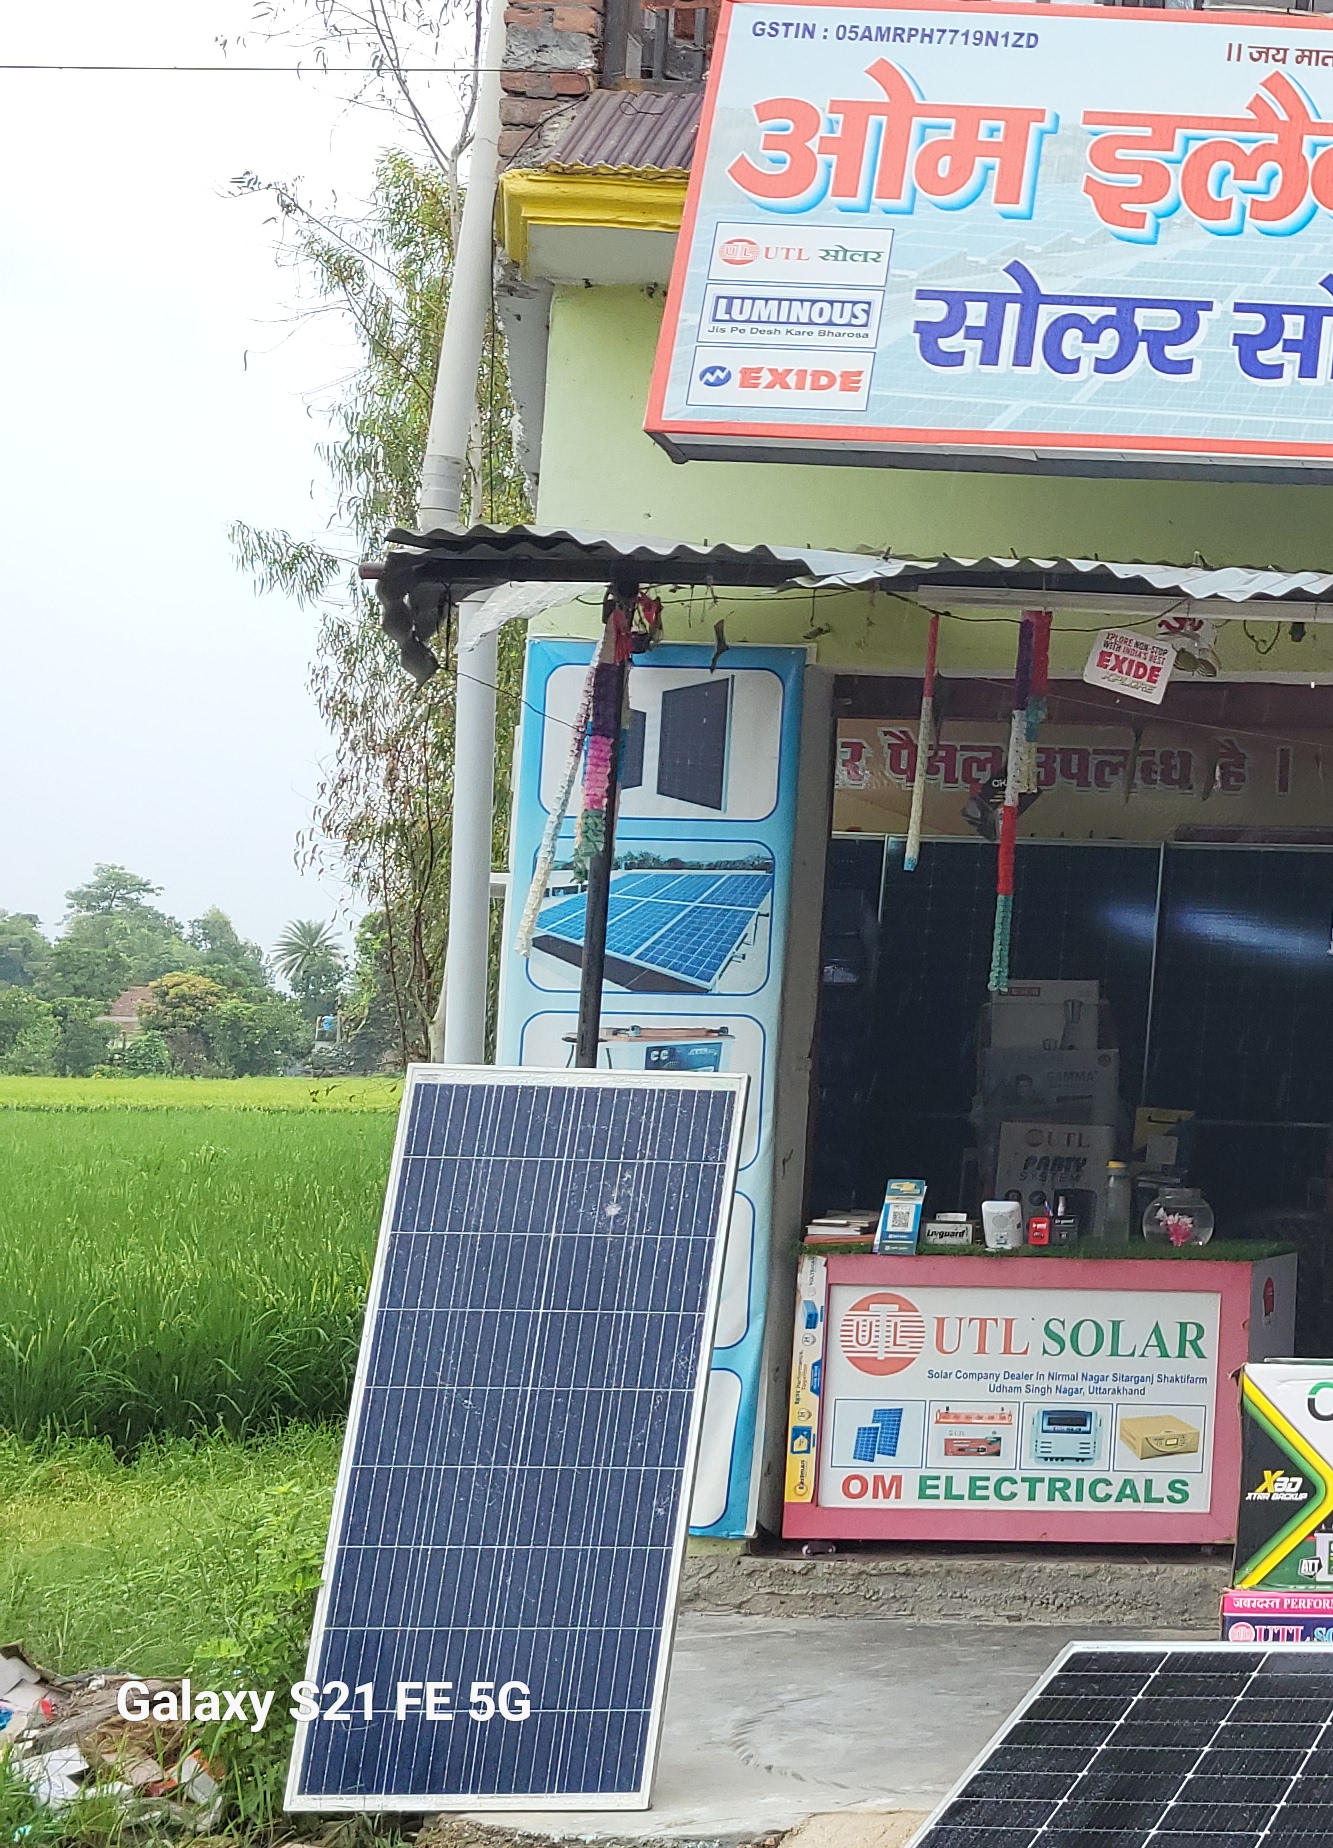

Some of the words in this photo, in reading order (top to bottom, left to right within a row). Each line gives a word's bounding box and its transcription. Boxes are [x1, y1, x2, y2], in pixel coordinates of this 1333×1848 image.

[751, 20, 814, 40] GSTIN
[835, 23, 1040, 50] 05AMRPH7719N1ZD
[1247, 44, 1290, 65] जय
[727, 56, 1054, 212] ओम
[763, 246, 811, 262] UTL
[817, 244, 885, 264] सोलर
[713, 297, 869, 326] LUMINOUS
[913, 259, 1214, 378] सोलर
[707, 325, 727, 334] Jis
[749, 326, 782, 336] Desh
[785, 328, 814, 338] Kare
[817, 329, 870, 340] Bharosa
[737, 365, 866, 393] EXIDE
[1096, 649, 1164, 686] EXIDE
[933, 1316, 1031, 1356] UTL
[1042, 1317, 1208, 1359] SOLAR
[927, 1369, 953, 1380] Solar
[955, 1369, 1000, 1383] Company
[1002, 1370, 1034, 1381] Dealer
[1047, 1371, 1079, 1382] Nirmal
[1081, 1371, 1110, 1385] Nagar
[1111, 1371, 1155, 1386] Sitarganj
[1156, 1373, 1208, 1385] Shaktifarm
[988, 1383, 1022, 1394] Udham
[1025, 1383, 1052, 1397] Singh
[1055, 1384, 1085, 1398] Nagar,
[1088, 1384, 1146, 1397] Uttarakhand
[841, 1473, 903, 1501] OM
[917, 1474, 1190, 1505] ELECTRICALS
